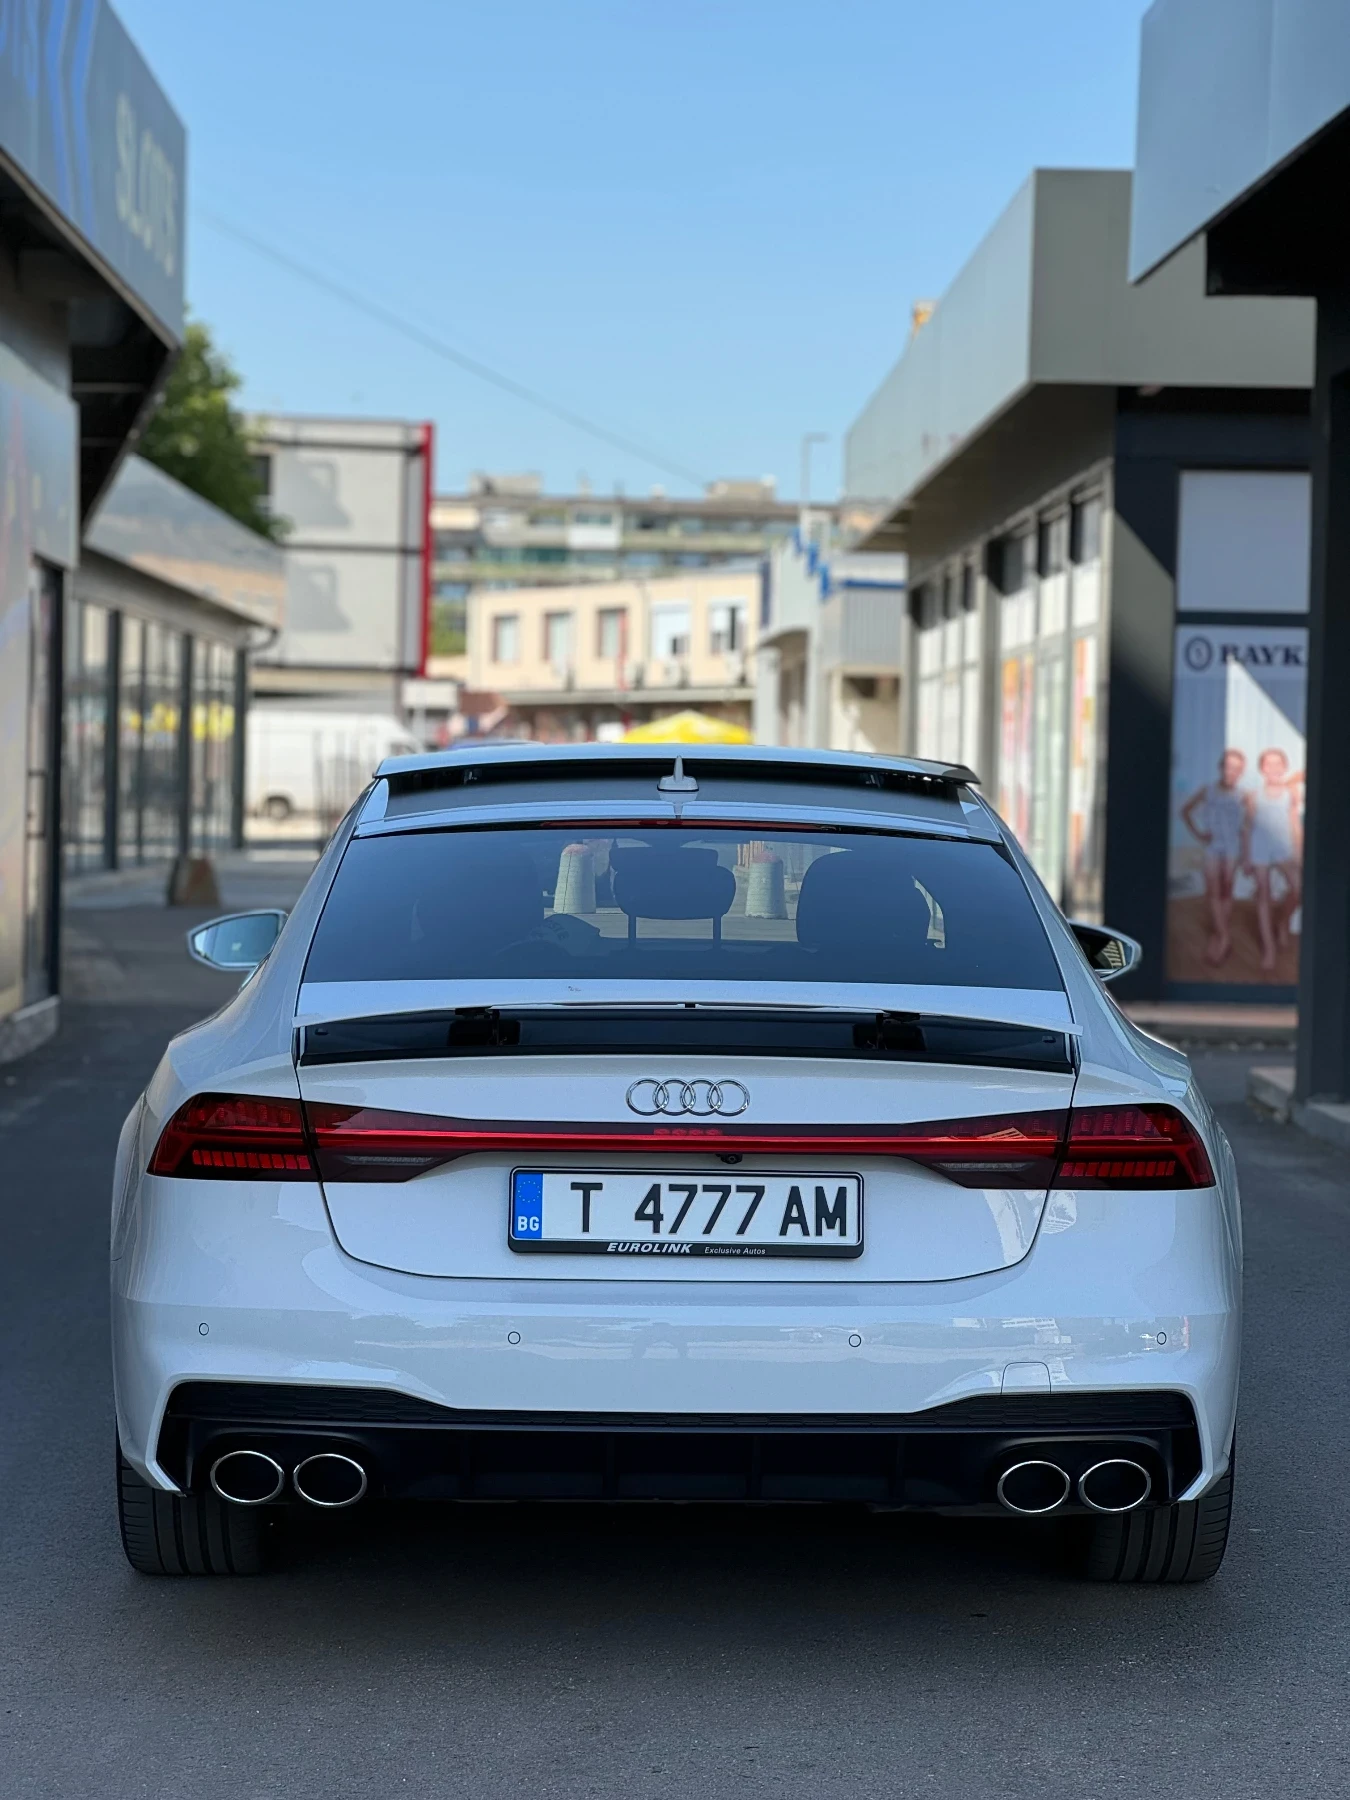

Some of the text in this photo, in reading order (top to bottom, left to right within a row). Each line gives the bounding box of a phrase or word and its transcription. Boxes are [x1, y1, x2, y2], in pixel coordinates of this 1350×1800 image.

[570, 1181, 848, 1237] T 4777 AM
[517, 1215, 540, 1232] BG
[606, 1242, 767, 1256] EUROLINK Exclusive Autos
